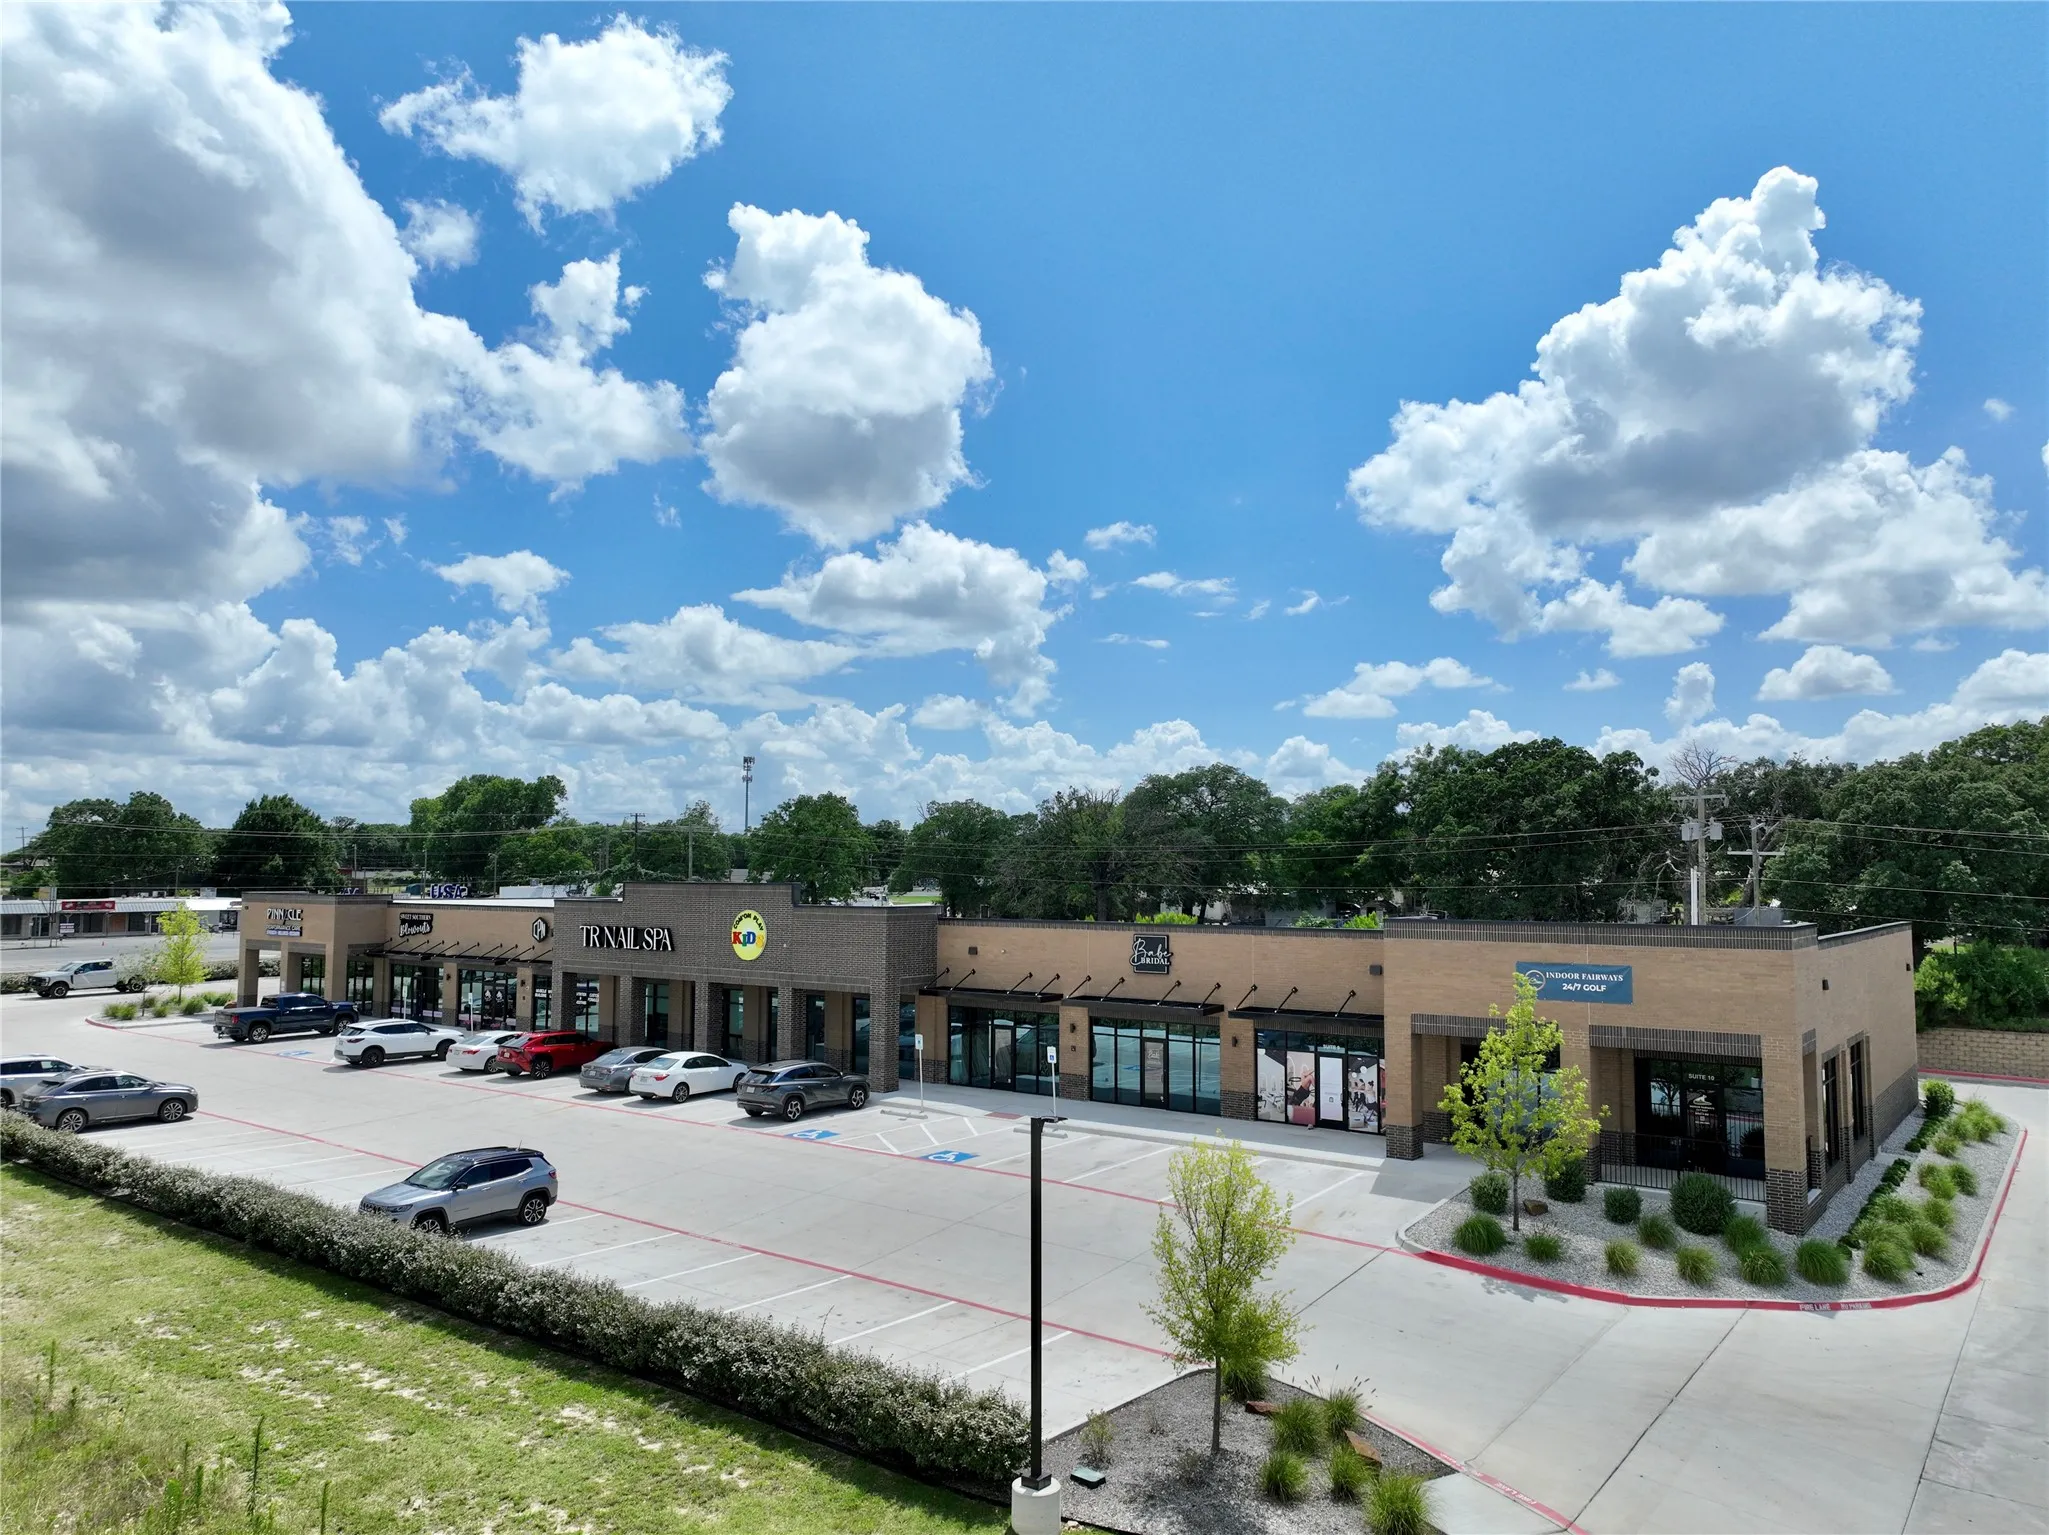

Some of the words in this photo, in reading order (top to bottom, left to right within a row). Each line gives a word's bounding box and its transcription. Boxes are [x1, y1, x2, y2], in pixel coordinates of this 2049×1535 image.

[753, 915, 764, 931] PLAY
[580, 925, 599, 948] TR
[603, 926, 639, 949] NAIL
[642, 927, 672, 951] SPA
[1130, 938, 1172, 965] Babe
[1140, 957, 1170, 965] BRIDAL
[1546, 971, 1580, 980] INDOOR
[1582, 973, 1624, 982] FAIRWAYS
[1562, 982, 1581, 991] 24/7
[1583, 984, 1606, 992] GOLF
[1799, 1303, 1814, 1311] FIRE
[1814, 1303, 1831, 1311] LANE
